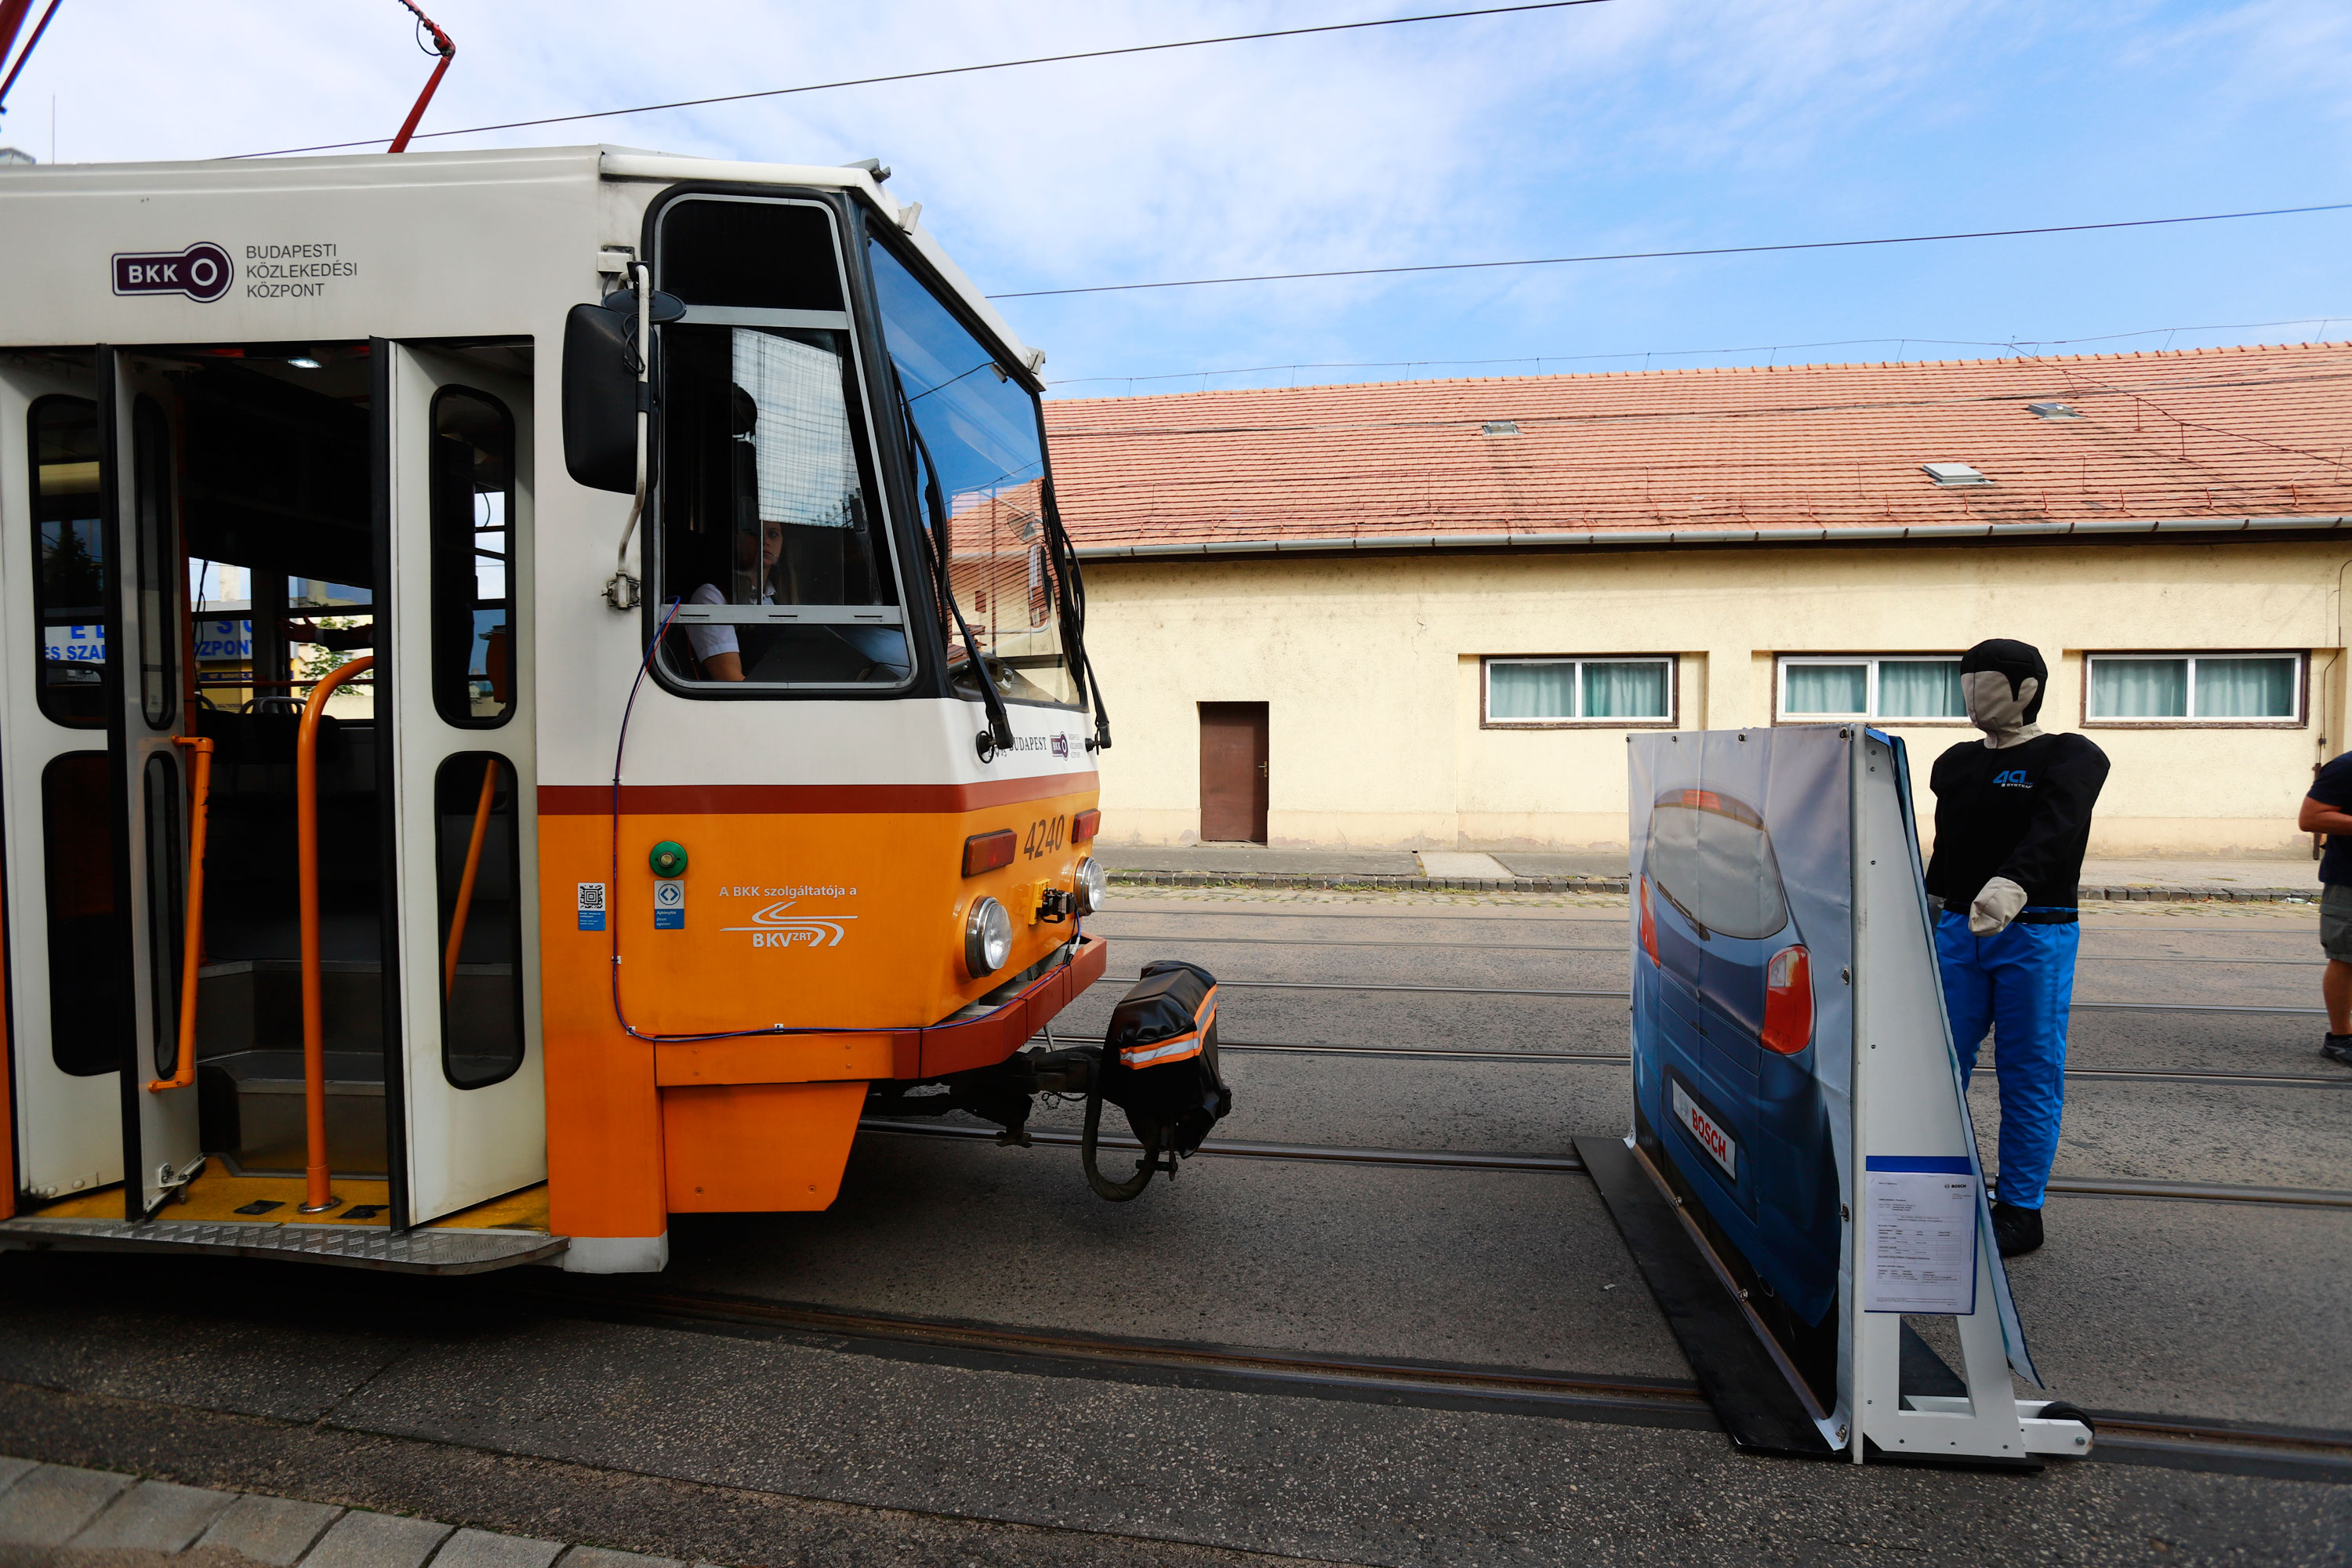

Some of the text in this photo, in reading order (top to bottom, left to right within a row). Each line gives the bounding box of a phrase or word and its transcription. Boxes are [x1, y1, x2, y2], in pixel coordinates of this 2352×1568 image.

[246, 244, 336, 259] BUDAPESTI
[129, 263, 179, 283] BKK
[246, 260, 358, 278] KÖZLEKEDÉSI
[246, 282, 325, 298] KÖZPONT
[67, 644, 105, 660] SZA
[1010, 737, 1047, 751] UDAPEST
[1023, 814, 1065, 861] 4240
[719, 885, 857, 899] A BKK szolgáltatója a
[752, 932, 813, 948] BKV ZRT
[1692, 1107, 1726, 1163] BOSCH
